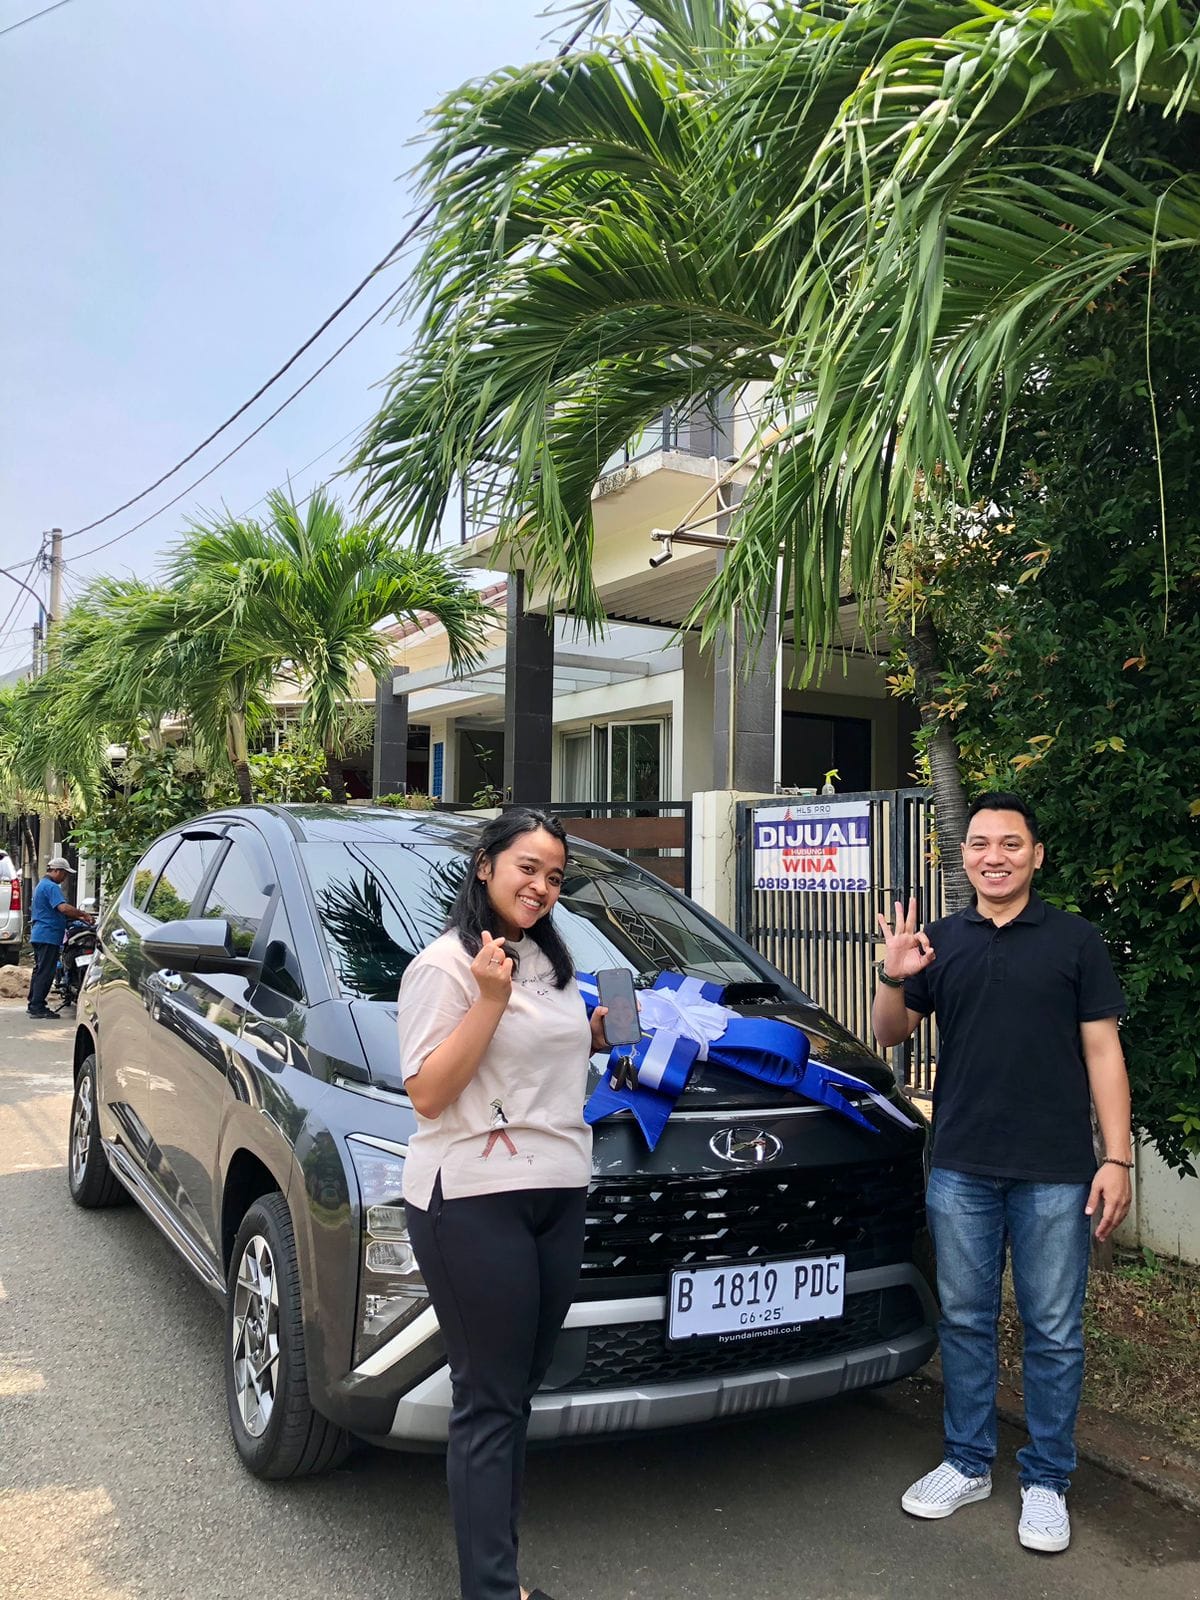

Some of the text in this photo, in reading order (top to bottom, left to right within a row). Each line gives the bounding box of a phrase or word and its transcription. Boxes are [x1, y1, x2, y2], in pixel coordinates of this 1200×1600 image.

[796, 805, 831, 814] HLS PRO
[758, 822, 867, 848] DIJUAL
[791, 848, 825, 856] HUBUNGI
[782, 858, 837, 873] WINA
[758, 877, 867, 891] 0819 1924 0122
[677, 1262, 840, 1313] B 1819 PDC
[718, 1324, 801, 1343] hyundaimobil.co.id
